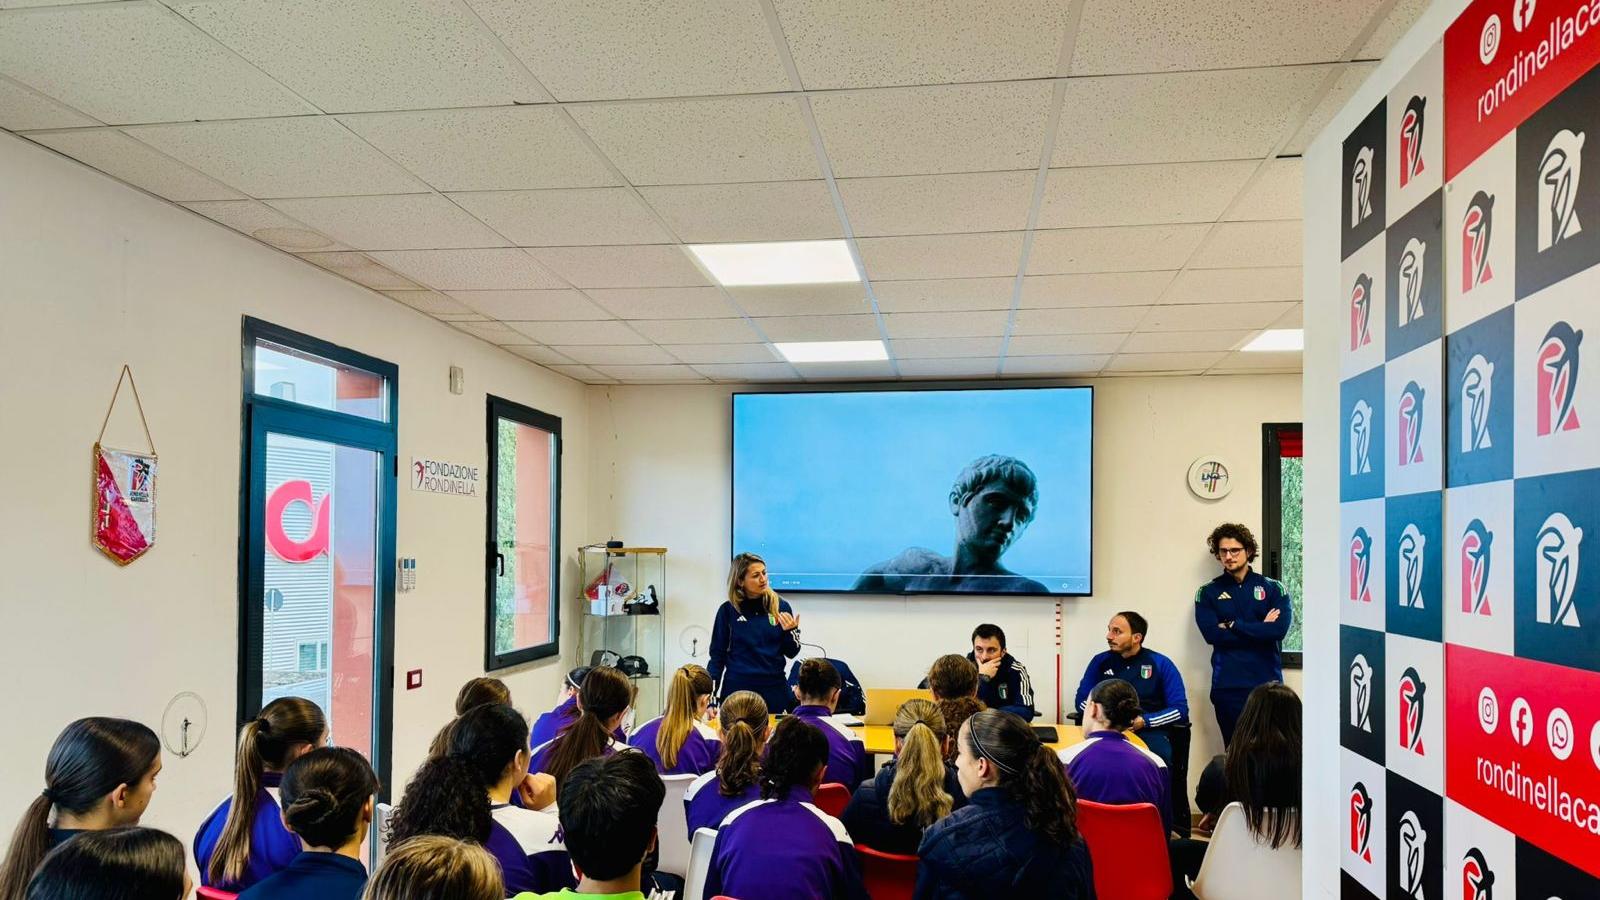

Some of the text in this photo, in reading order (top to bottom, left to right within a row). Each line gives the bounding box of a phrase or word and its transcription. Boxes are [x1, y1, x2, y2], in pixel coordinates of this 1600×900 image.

[425, 460, 478, 481] FONDAZIONE
[425, 477, 476, 495] RONDINELLA
[1477, 756, 1600, 835] rondinellaca
